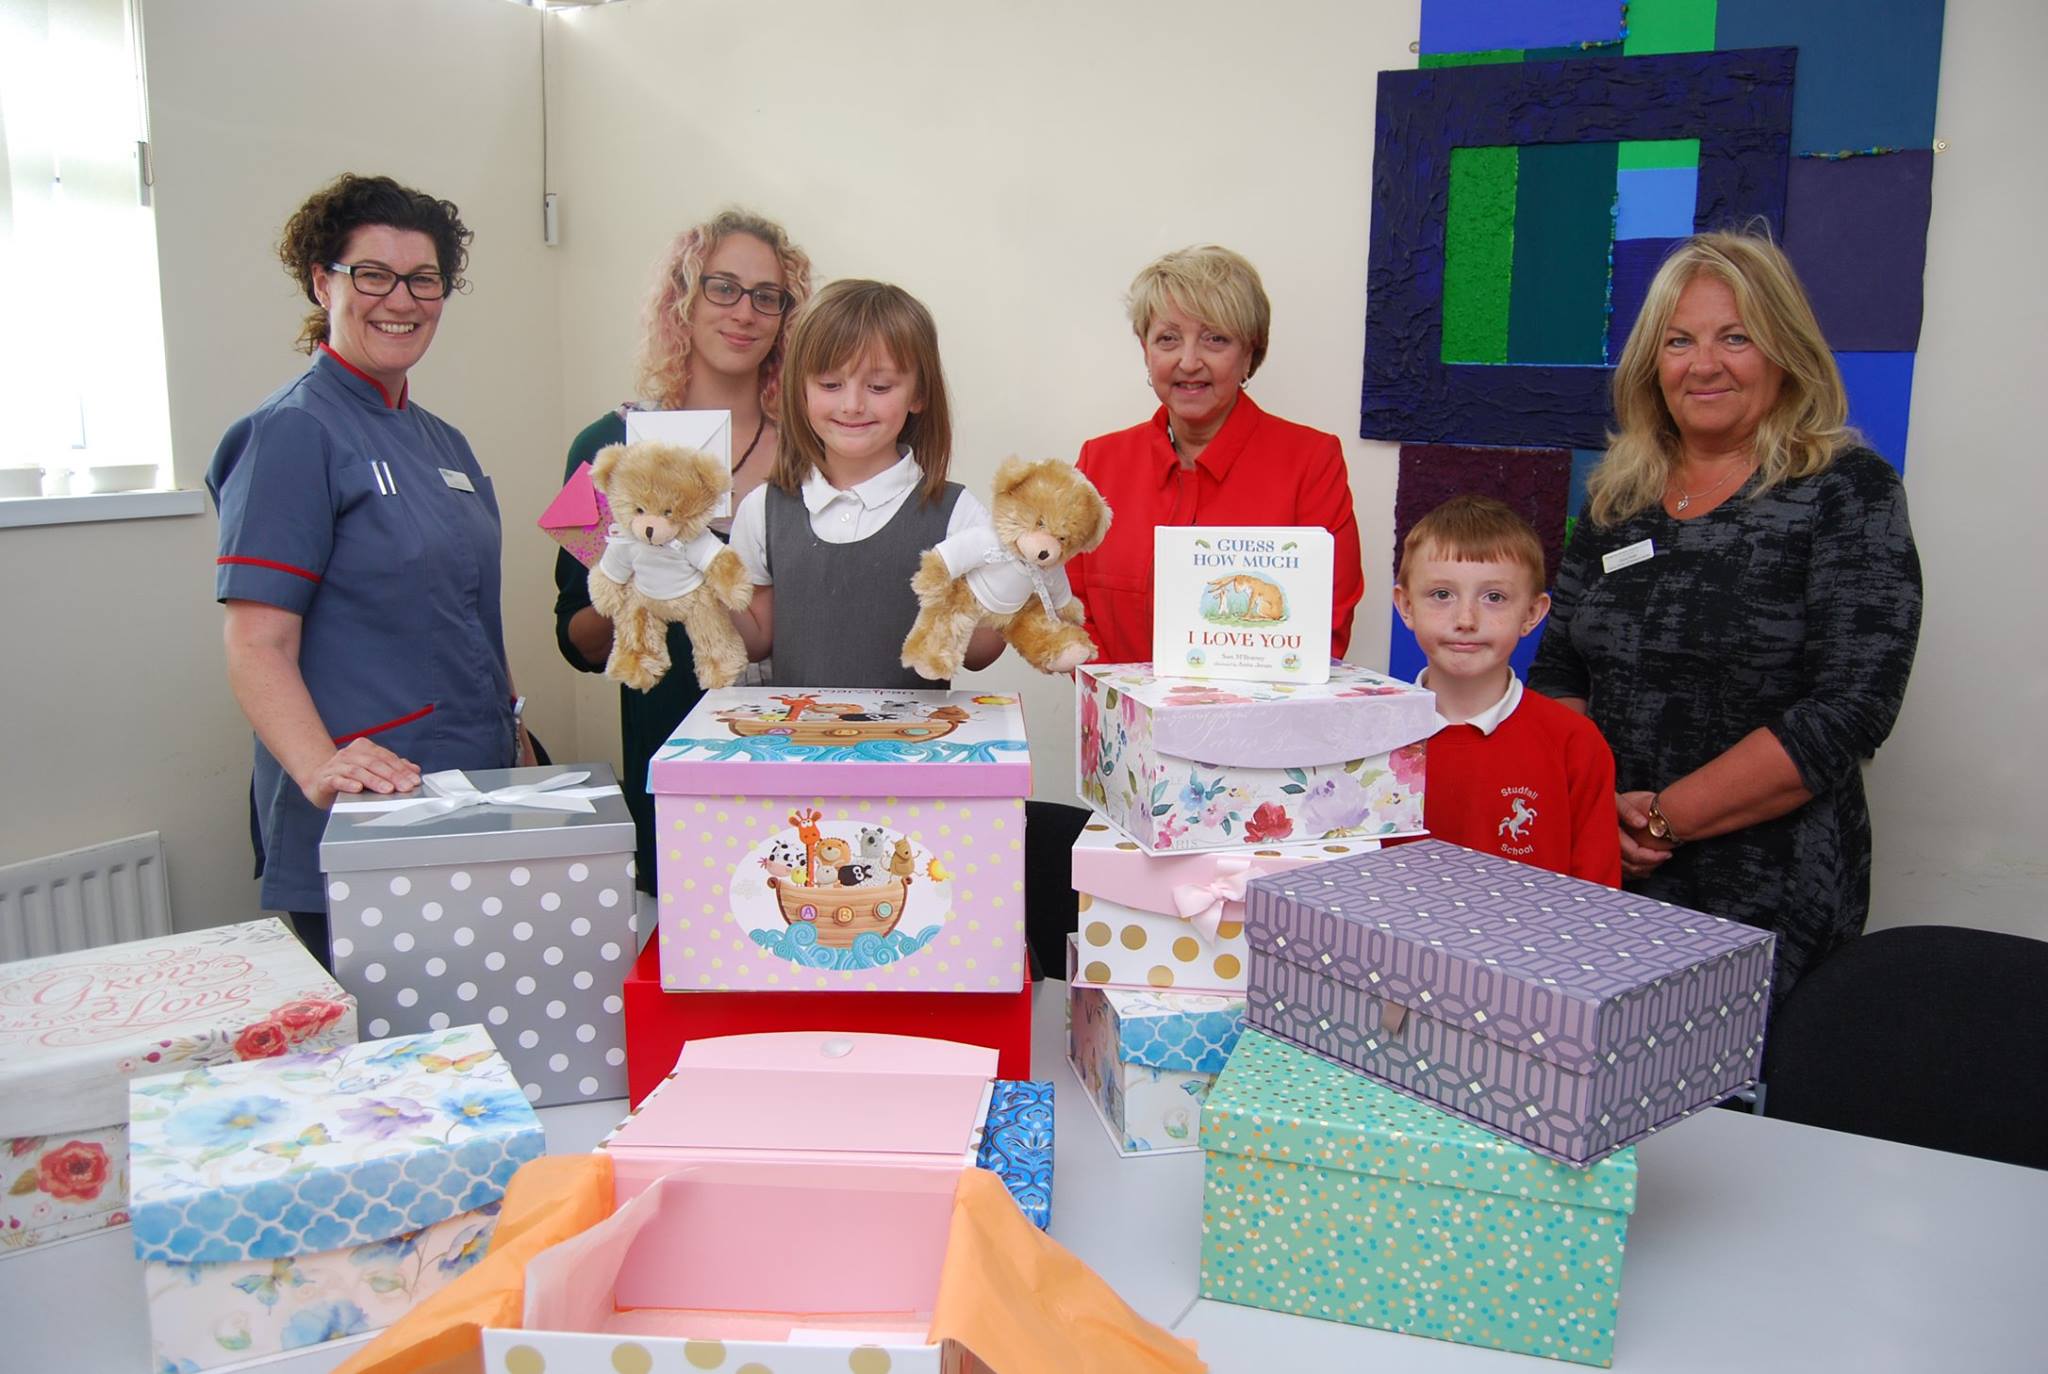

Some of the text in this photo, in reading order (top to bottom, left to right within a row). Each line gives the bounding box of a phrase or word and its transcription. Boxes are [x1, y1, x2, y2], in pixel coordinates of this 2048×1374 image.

[1217, 538, 1275, 552] GUESS
[1193, 553, 1299, 569] HOW MUCH
[1188, 630, 1302, 649] I LOVE YOU
[1500, 786, 1538, 800] Studfall
[1500, 843, 1534, 856] School
